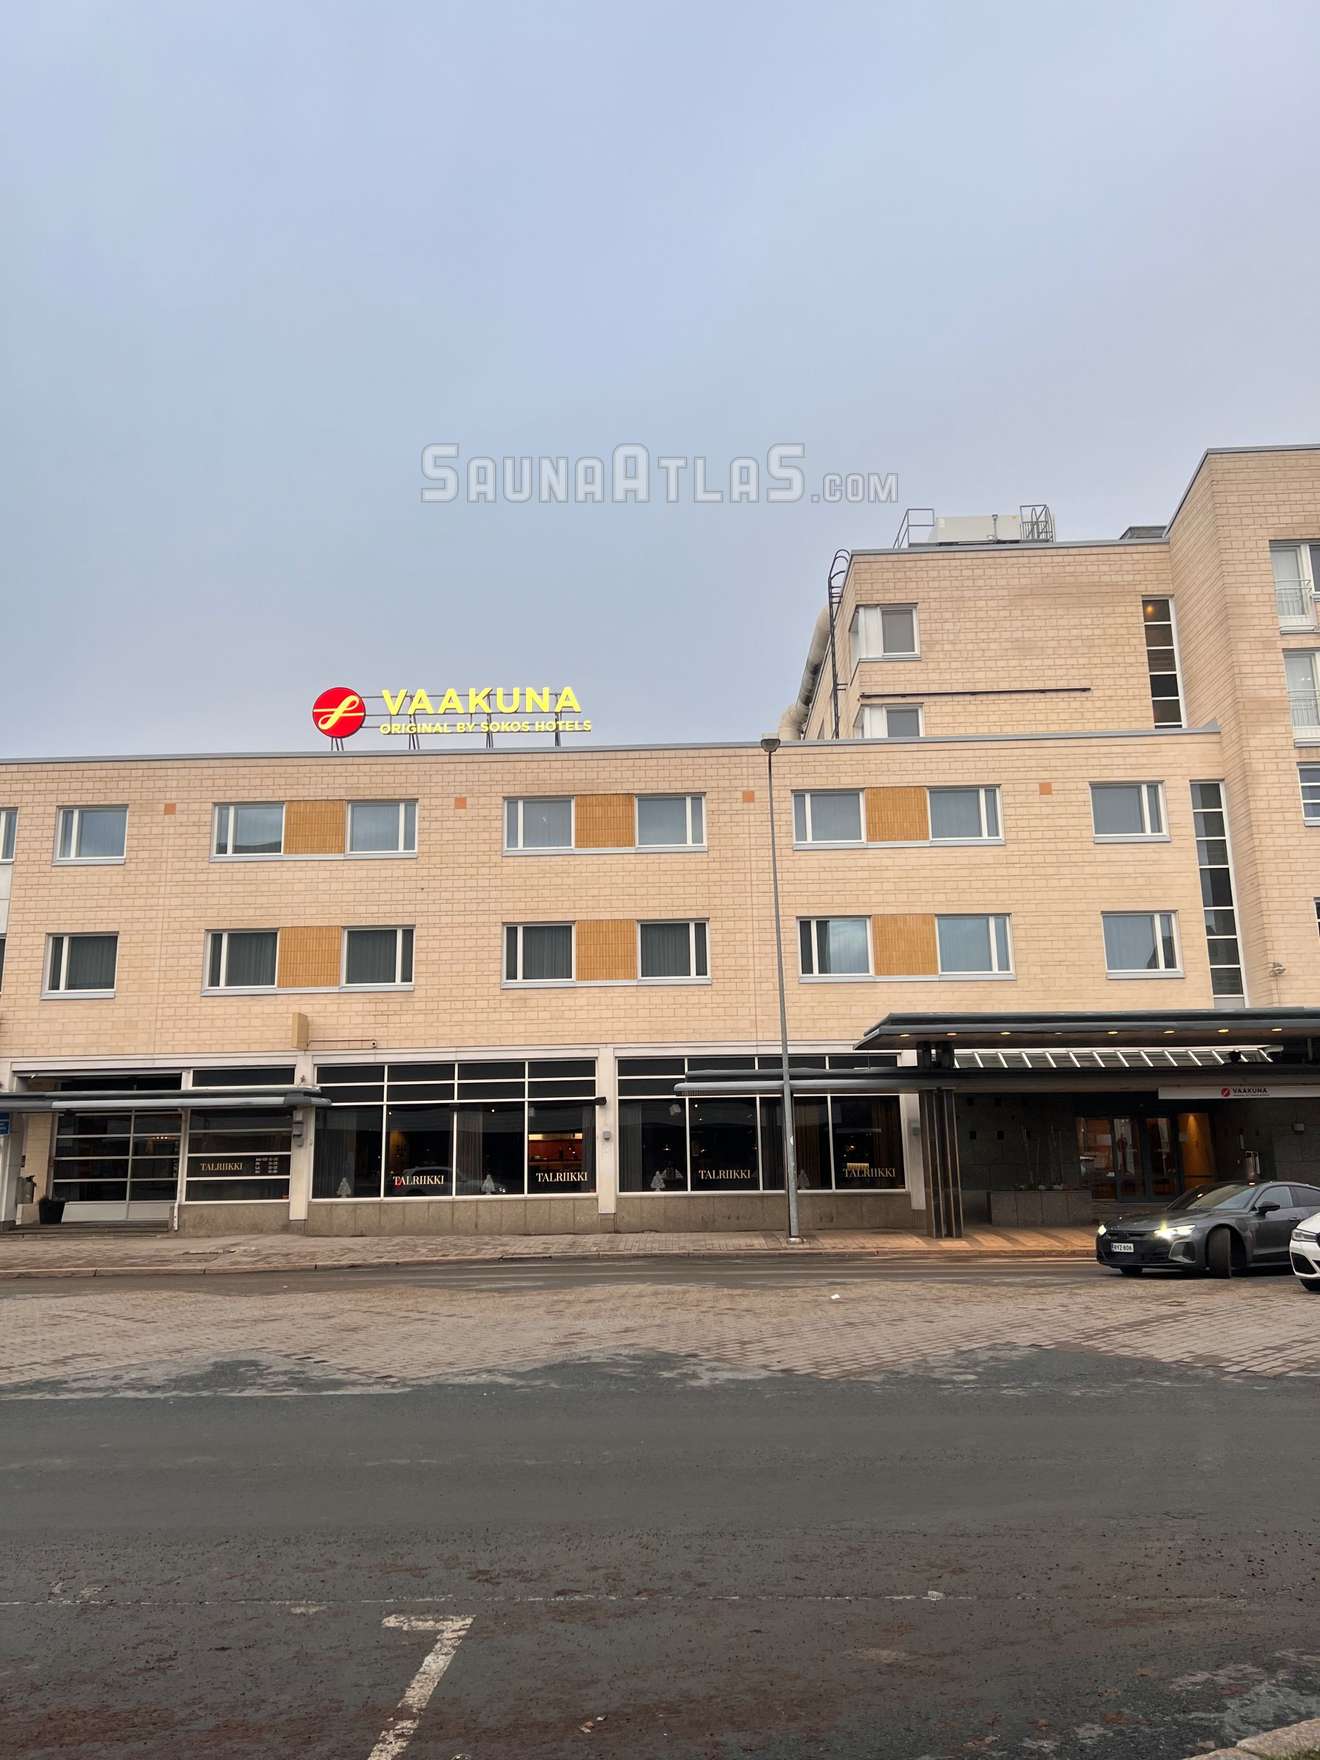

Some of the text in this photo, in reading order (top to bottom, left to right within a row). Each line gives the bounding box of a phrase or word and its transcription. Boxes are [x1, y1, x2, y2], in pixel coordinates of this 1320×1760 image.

[381, 687, 581, 716] VAAKUNA
[379, 720, 592, 735] ORIGINAL BY SOKOS HOTELS
[200, 1162, 243, 1171] TALRIIKKI
[535, 1171, 588, 1182] TALRIIKKI
[698, 1169, 751, 1180] TALRIIKKI
[842, 1167, 896, 1178] TALRIIKKI
[392, 1175, 445, 1186] TALRIIKKI
